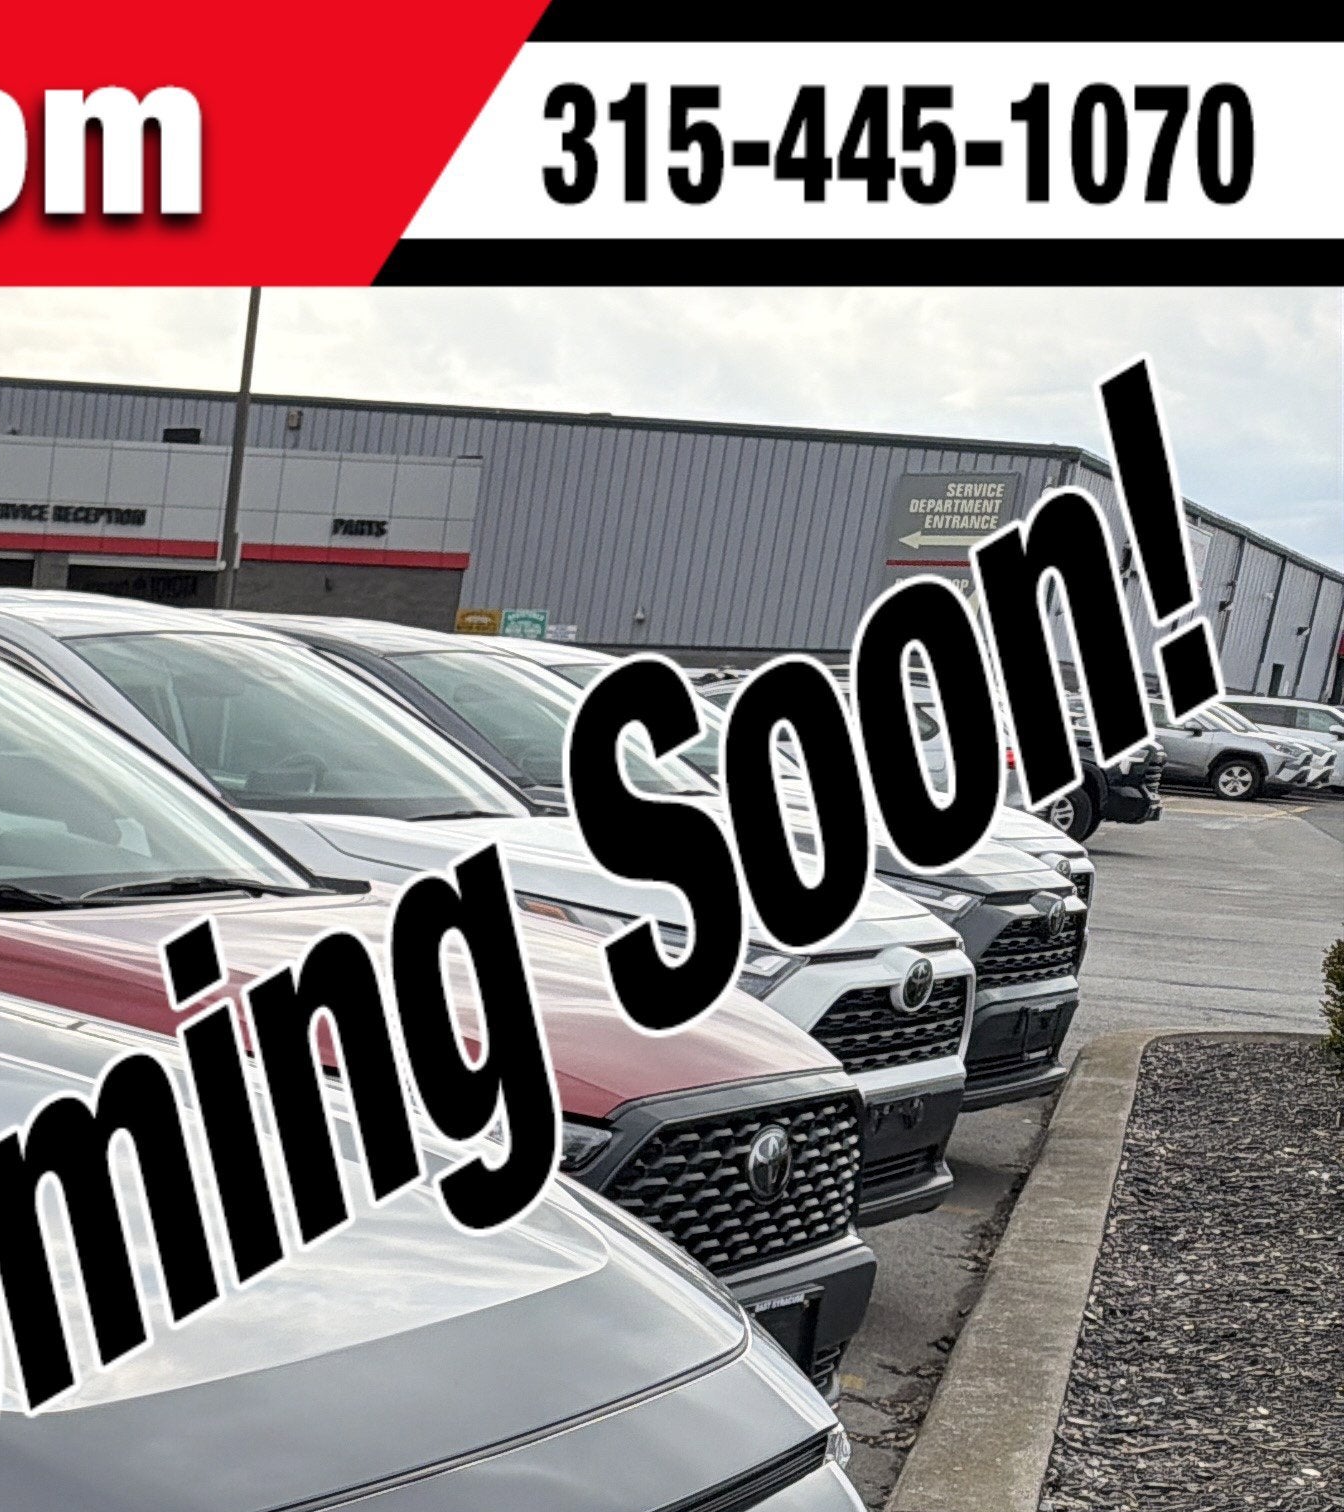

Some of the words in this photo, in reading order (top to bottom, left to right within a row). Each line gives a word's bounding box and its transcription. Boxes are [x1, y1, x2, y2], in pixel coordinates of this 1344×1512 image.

[946, 483, 1005, 498] SERVICE
[909, 499, 1002, 515] DEPARTMENT
[52, 505, 147, 526] RECEPTION
[924, 515, 998, 529] ENTRANCE
[332, 518, 388, 537] PARTS
